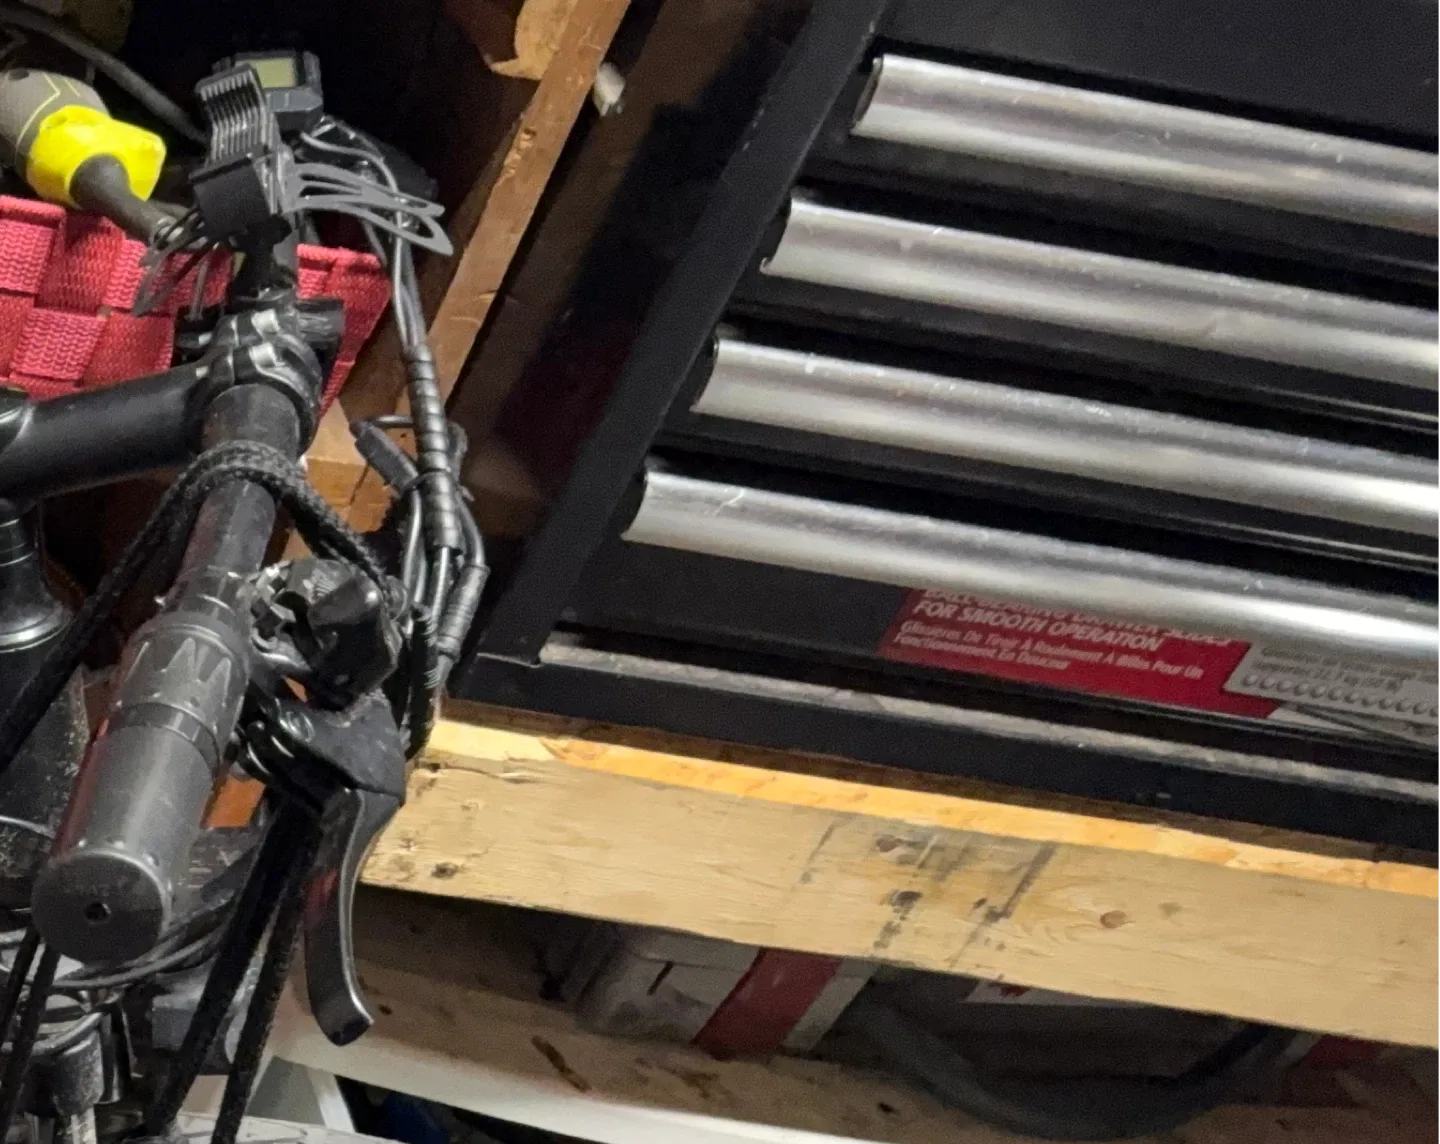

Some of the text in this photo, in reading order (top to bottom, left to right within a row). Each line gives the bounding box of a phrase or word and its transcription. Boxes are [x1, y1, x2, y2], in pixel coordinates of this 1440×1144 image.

[913, 600, 1166, 651] FOR SMOOTH OPERATION
